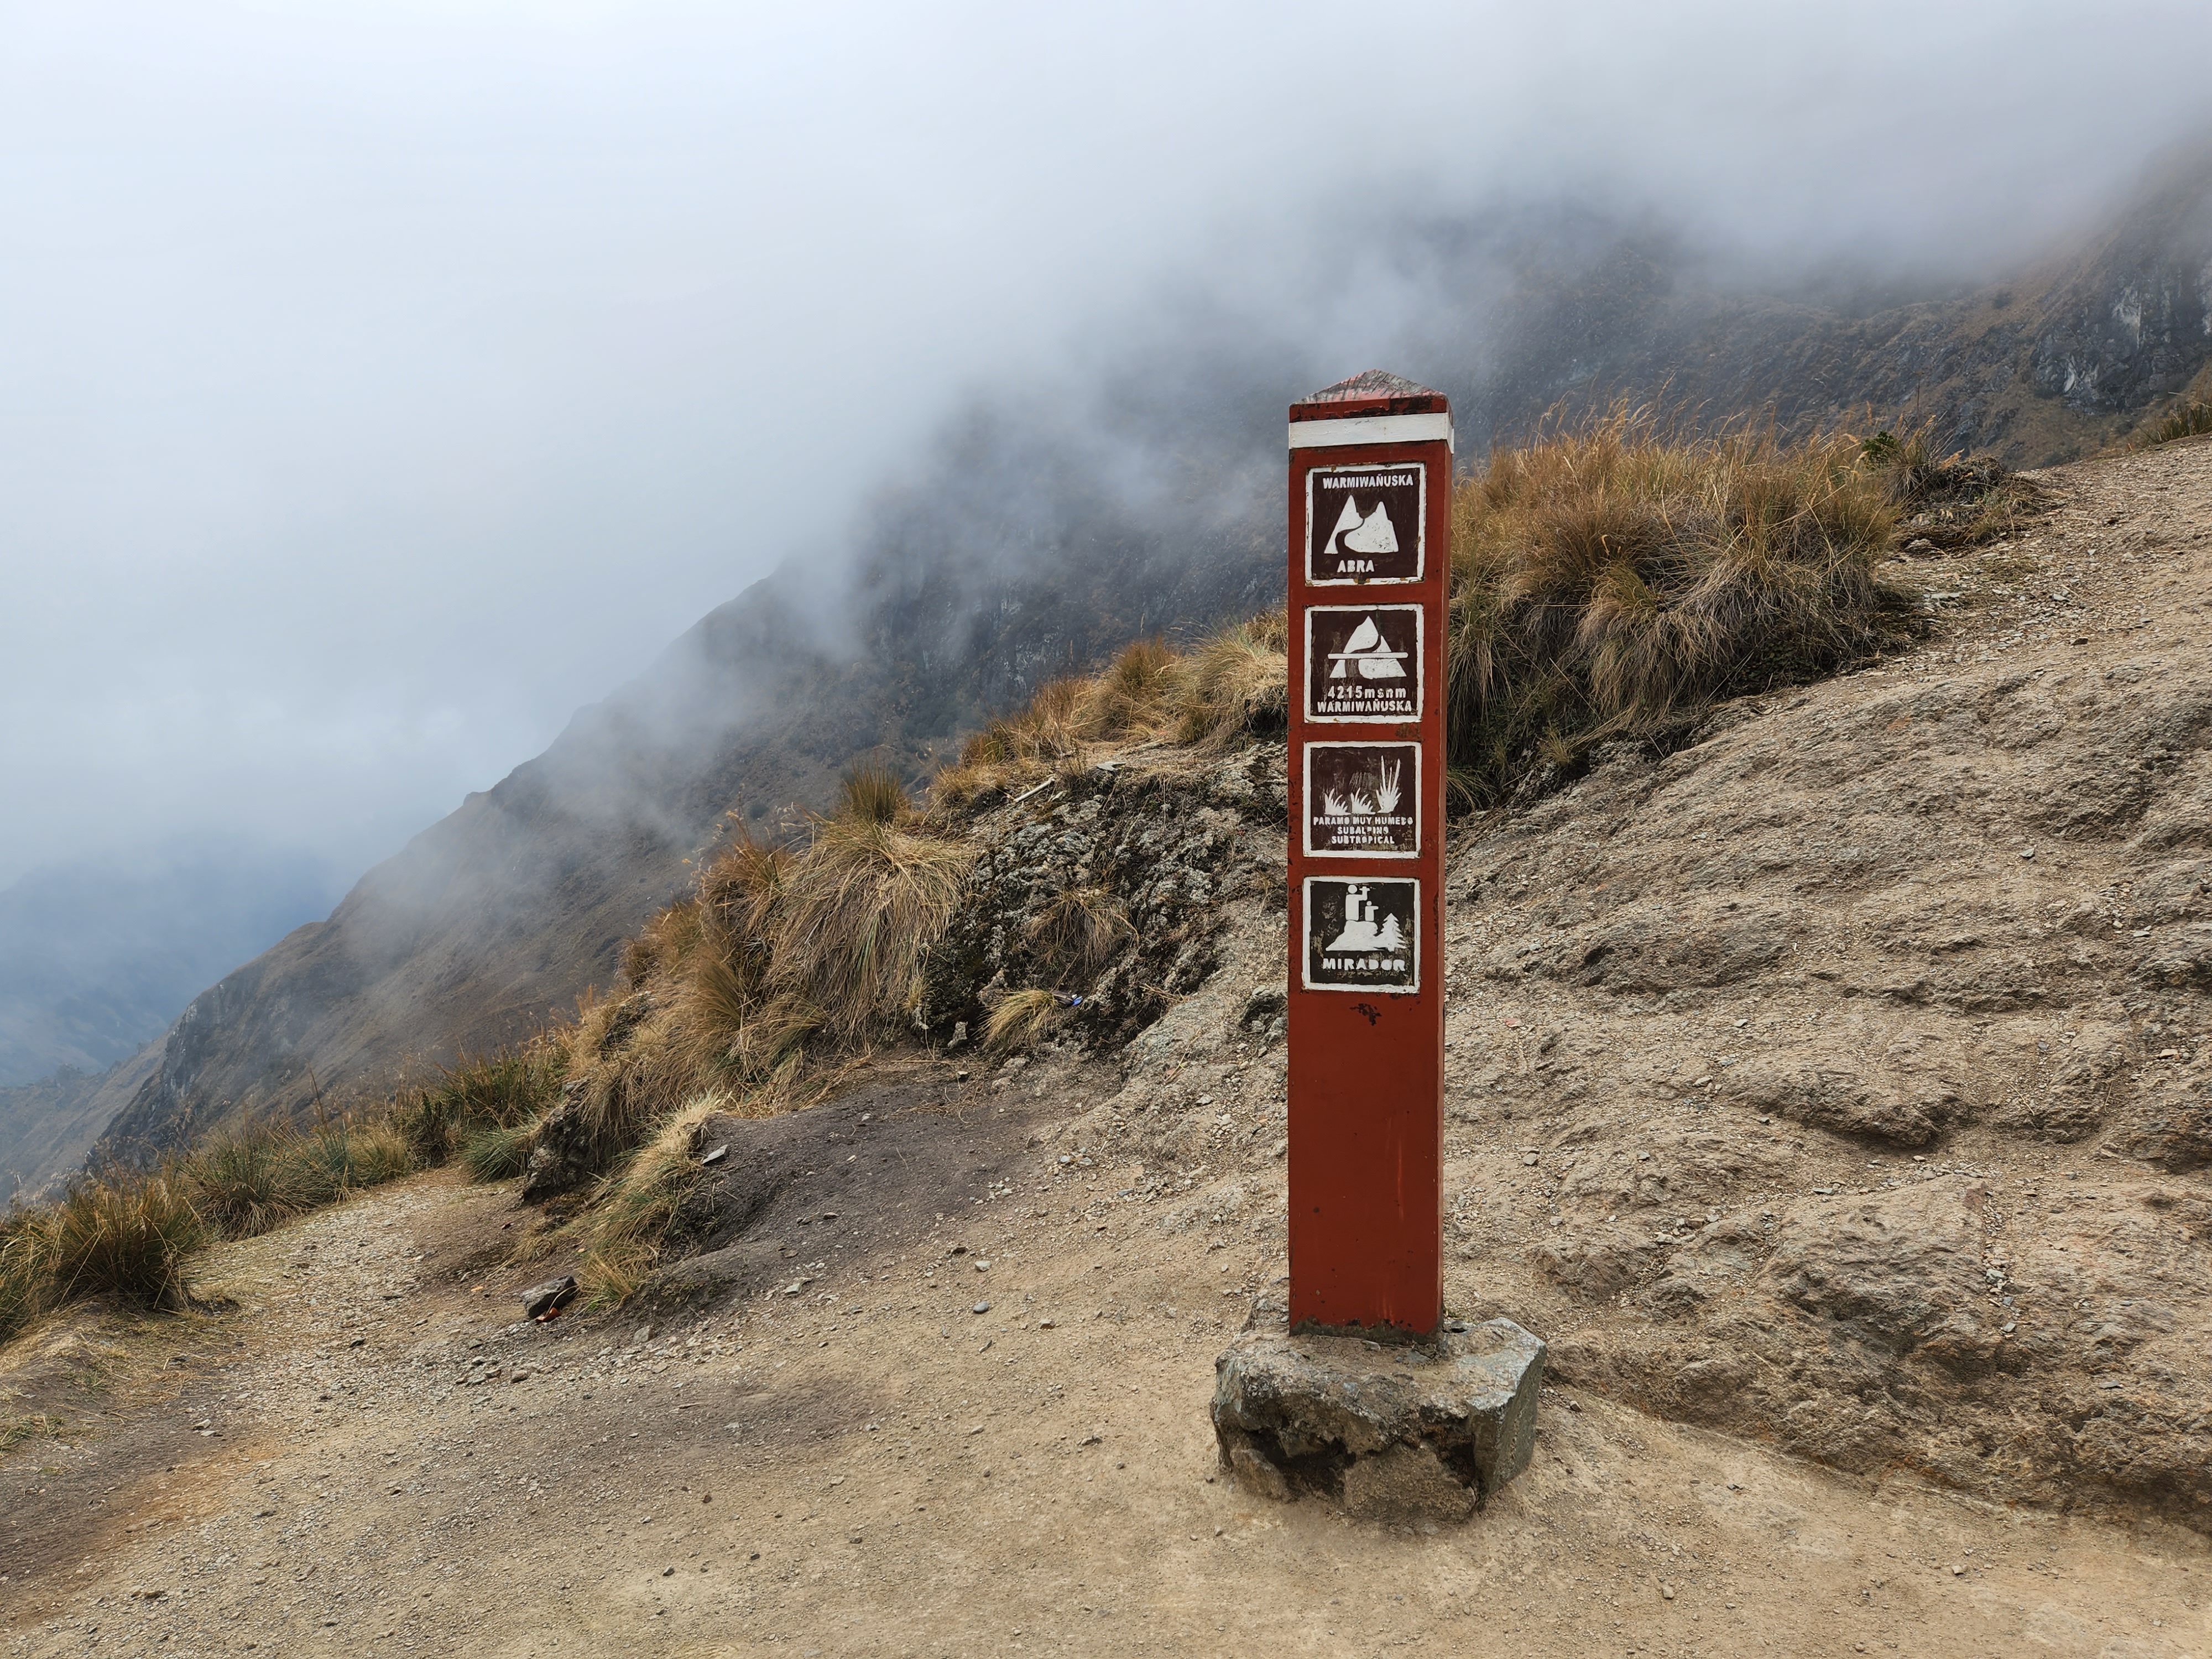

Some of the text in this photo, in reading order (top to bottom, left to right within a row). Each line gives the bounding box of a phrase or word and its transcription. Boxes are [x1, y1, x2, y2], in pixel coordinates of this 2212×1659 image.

[1323, 473, 1413, 489] WARMIWAÑUSKA
[1337, 560, 1375, 572] ABRA
[1332, 836, 1395, 844] SUBTROPICAL
[1323, 958, 1405, 971] MIRADOR
